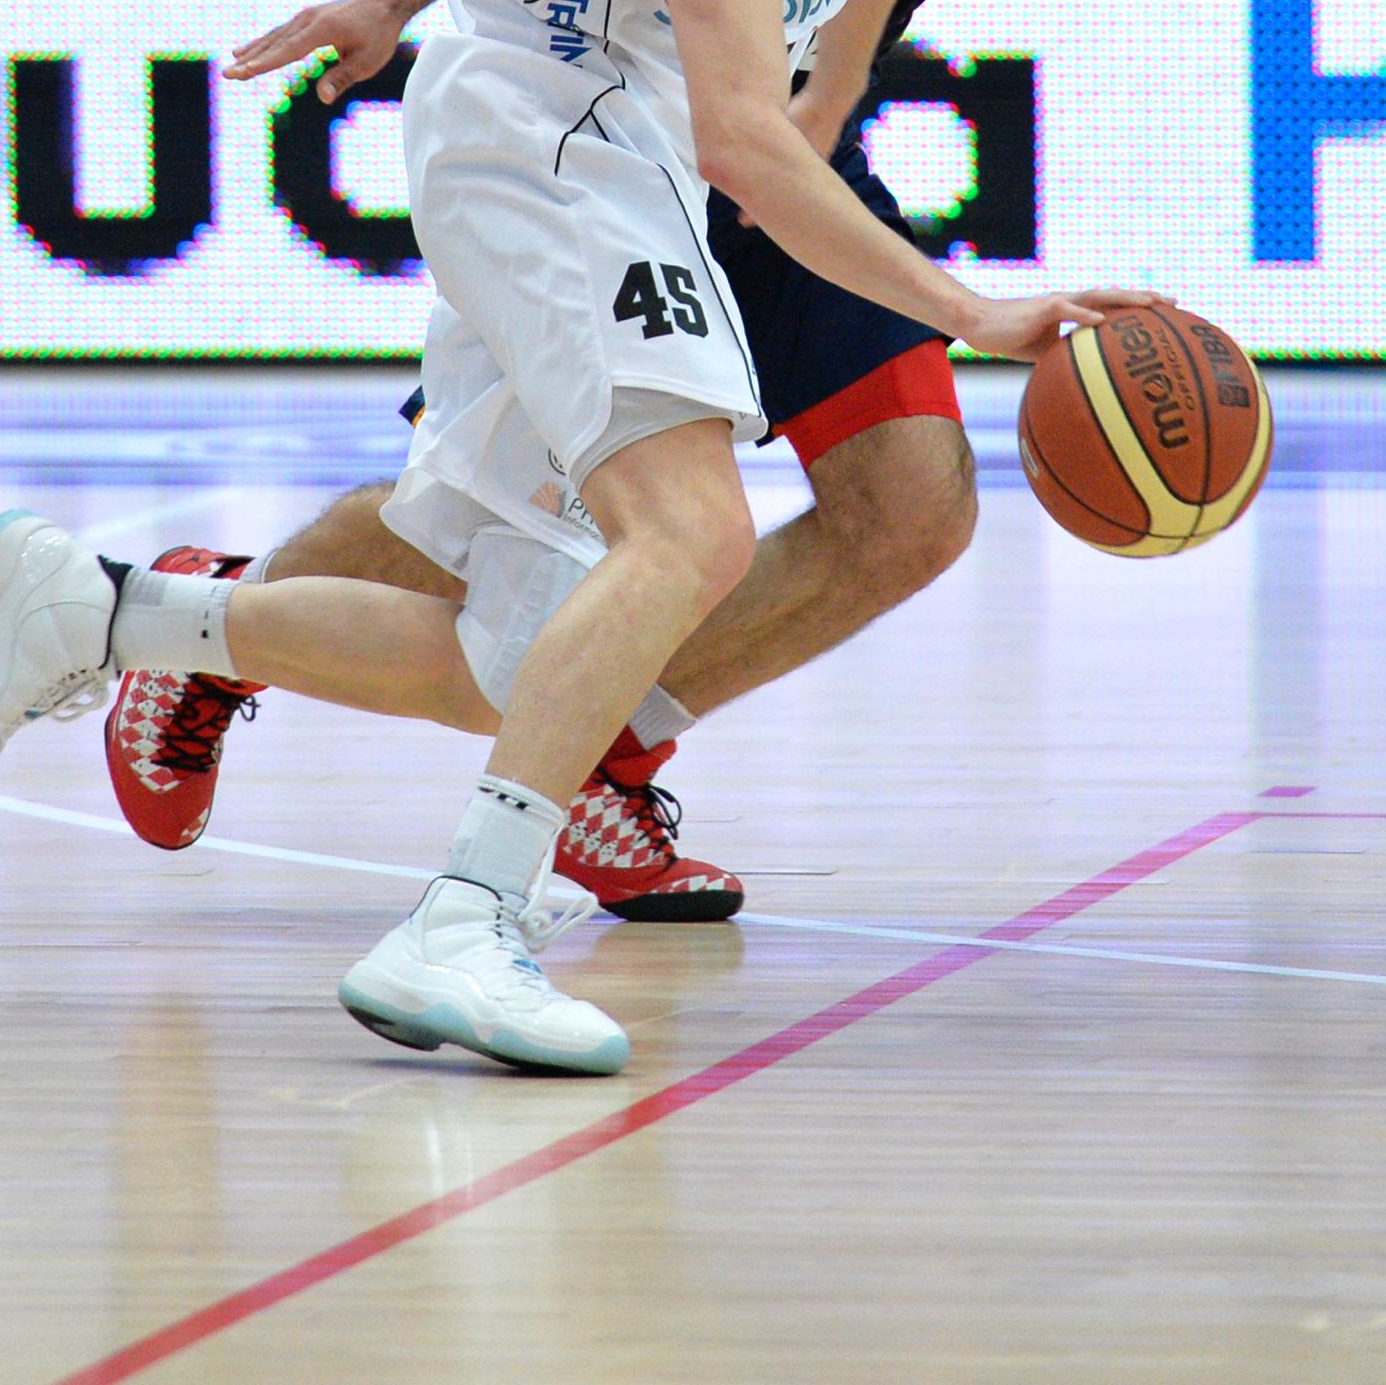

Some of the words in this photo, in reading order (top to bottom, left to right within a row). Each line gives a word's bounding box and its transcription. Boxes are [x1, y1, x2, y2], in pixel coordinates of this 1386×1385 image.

[613, 261, 709, 340] 45
[1109, 313, 1190, 450] molten
[1154, 328, 1197, 411] OFFICIAL
[1190, 324, 1242, 386] FIBA
